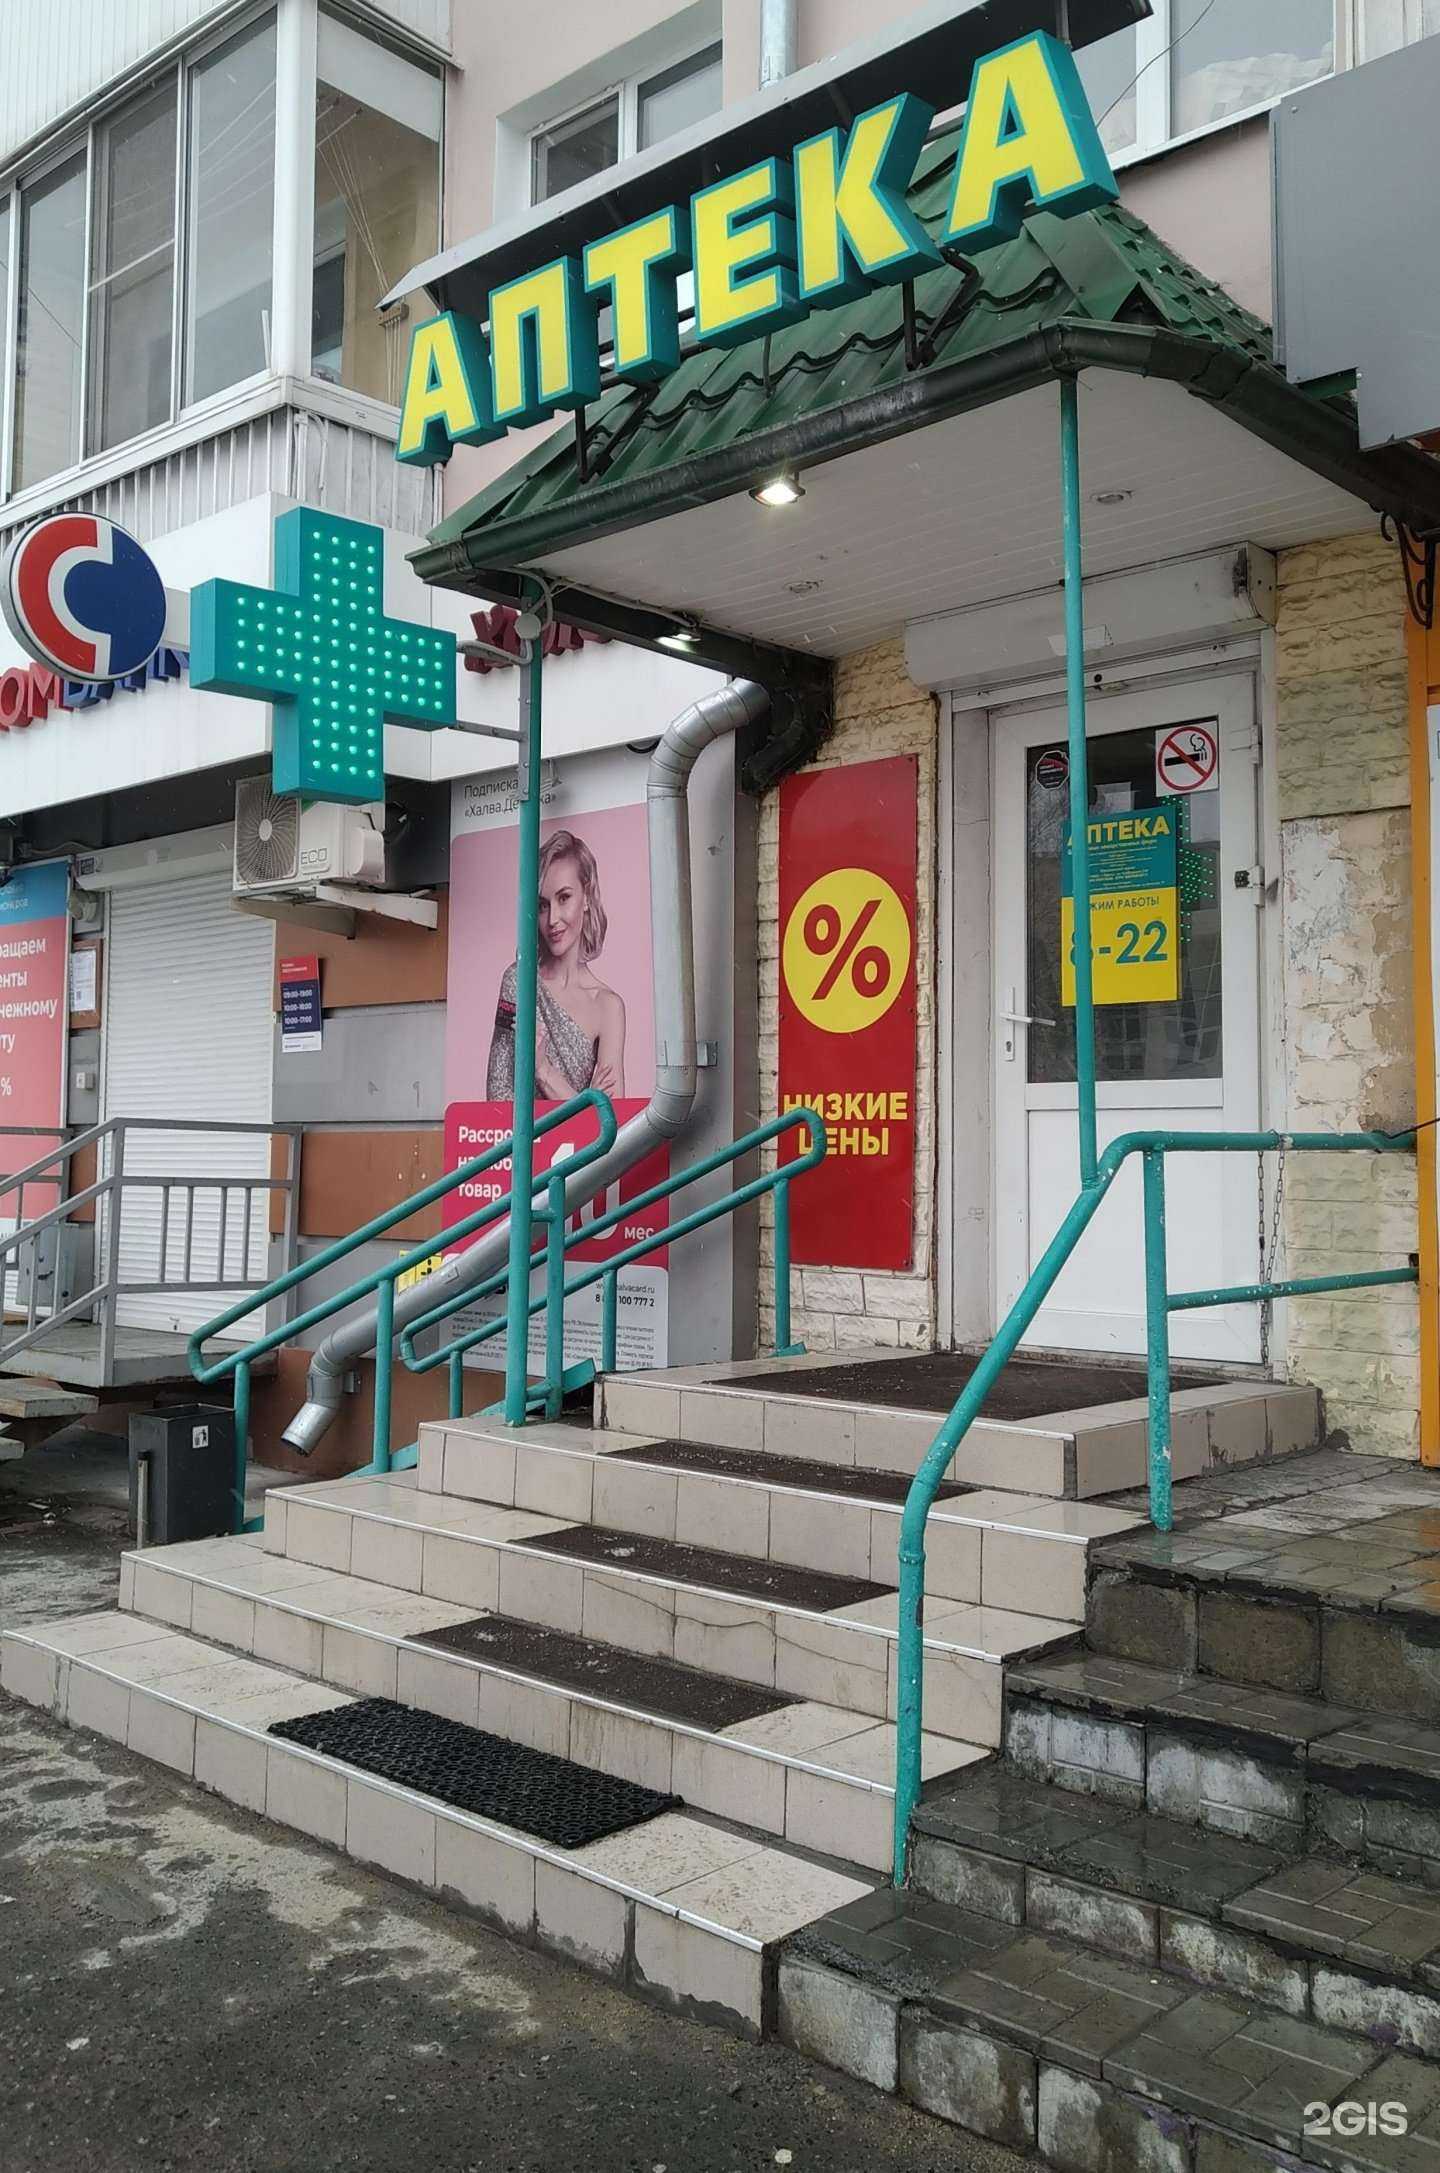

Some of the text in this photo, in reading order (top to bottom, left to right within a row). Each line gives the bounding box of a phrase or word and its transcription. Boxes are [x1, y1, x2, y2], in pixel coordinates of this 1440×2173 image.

[396, 28, 1118, 467] АПТЕКА
[464, 780, 519, 799] Подписка
[1067, 816, 1170, 847] ПТЕКА
[1118, 896, 1160, 909] РАБОТЫ
[0, 938, 46, 959] ащаем
[1071, 920, 1168, 964] -22
[783, 1091, 908, 1121] НИЗКИЕ
[458, 1126, 541, 1147] Рассро
[458, 1183, 501, 1202] товар
[624, 1226, 655, 1240] мес
[618, 1295, 632, 1305] 100
[633, 1296, 648, 1306] 777
[649, 1298, 655, 1307] 2
